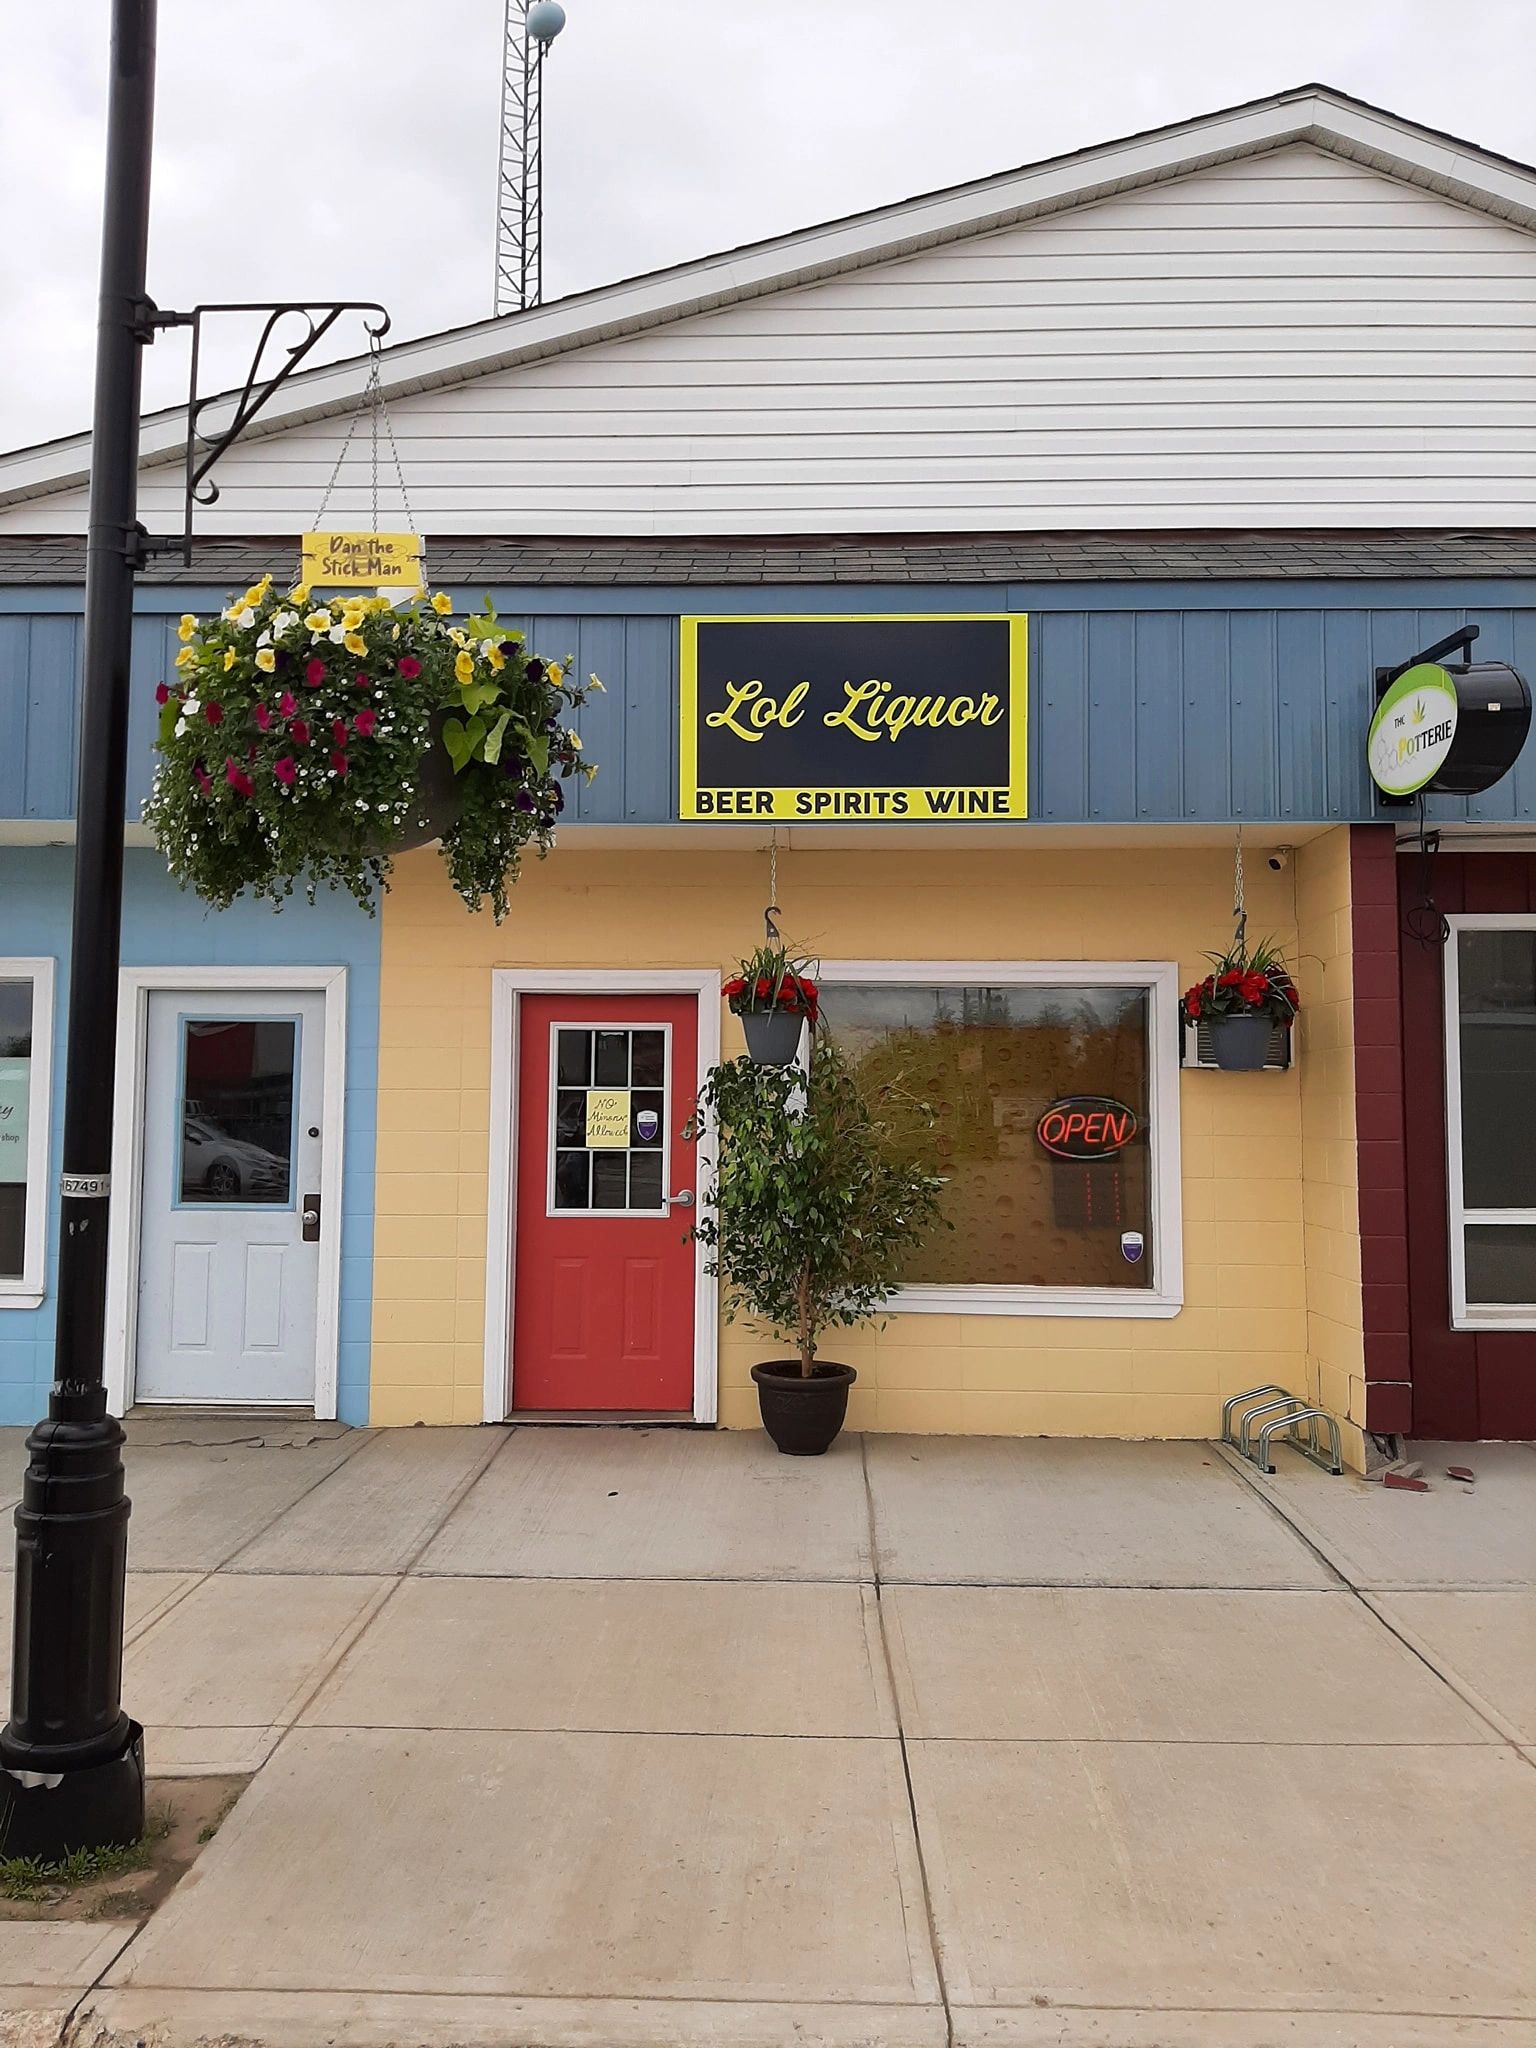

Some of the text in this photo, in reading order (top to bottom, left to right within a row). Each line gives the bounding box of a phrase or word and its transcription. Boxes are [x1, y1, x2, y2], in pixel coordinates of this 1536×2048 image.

[329, 535, 361, 554] Dan
[321, 556, 402, 577] Stick Man
[705, 679, 1005, 743] Lol Liquor
[695, 789, 1010, 816] BEER SPIRITS WINE
[1043, 1112, 1127, 1143] OPEN
